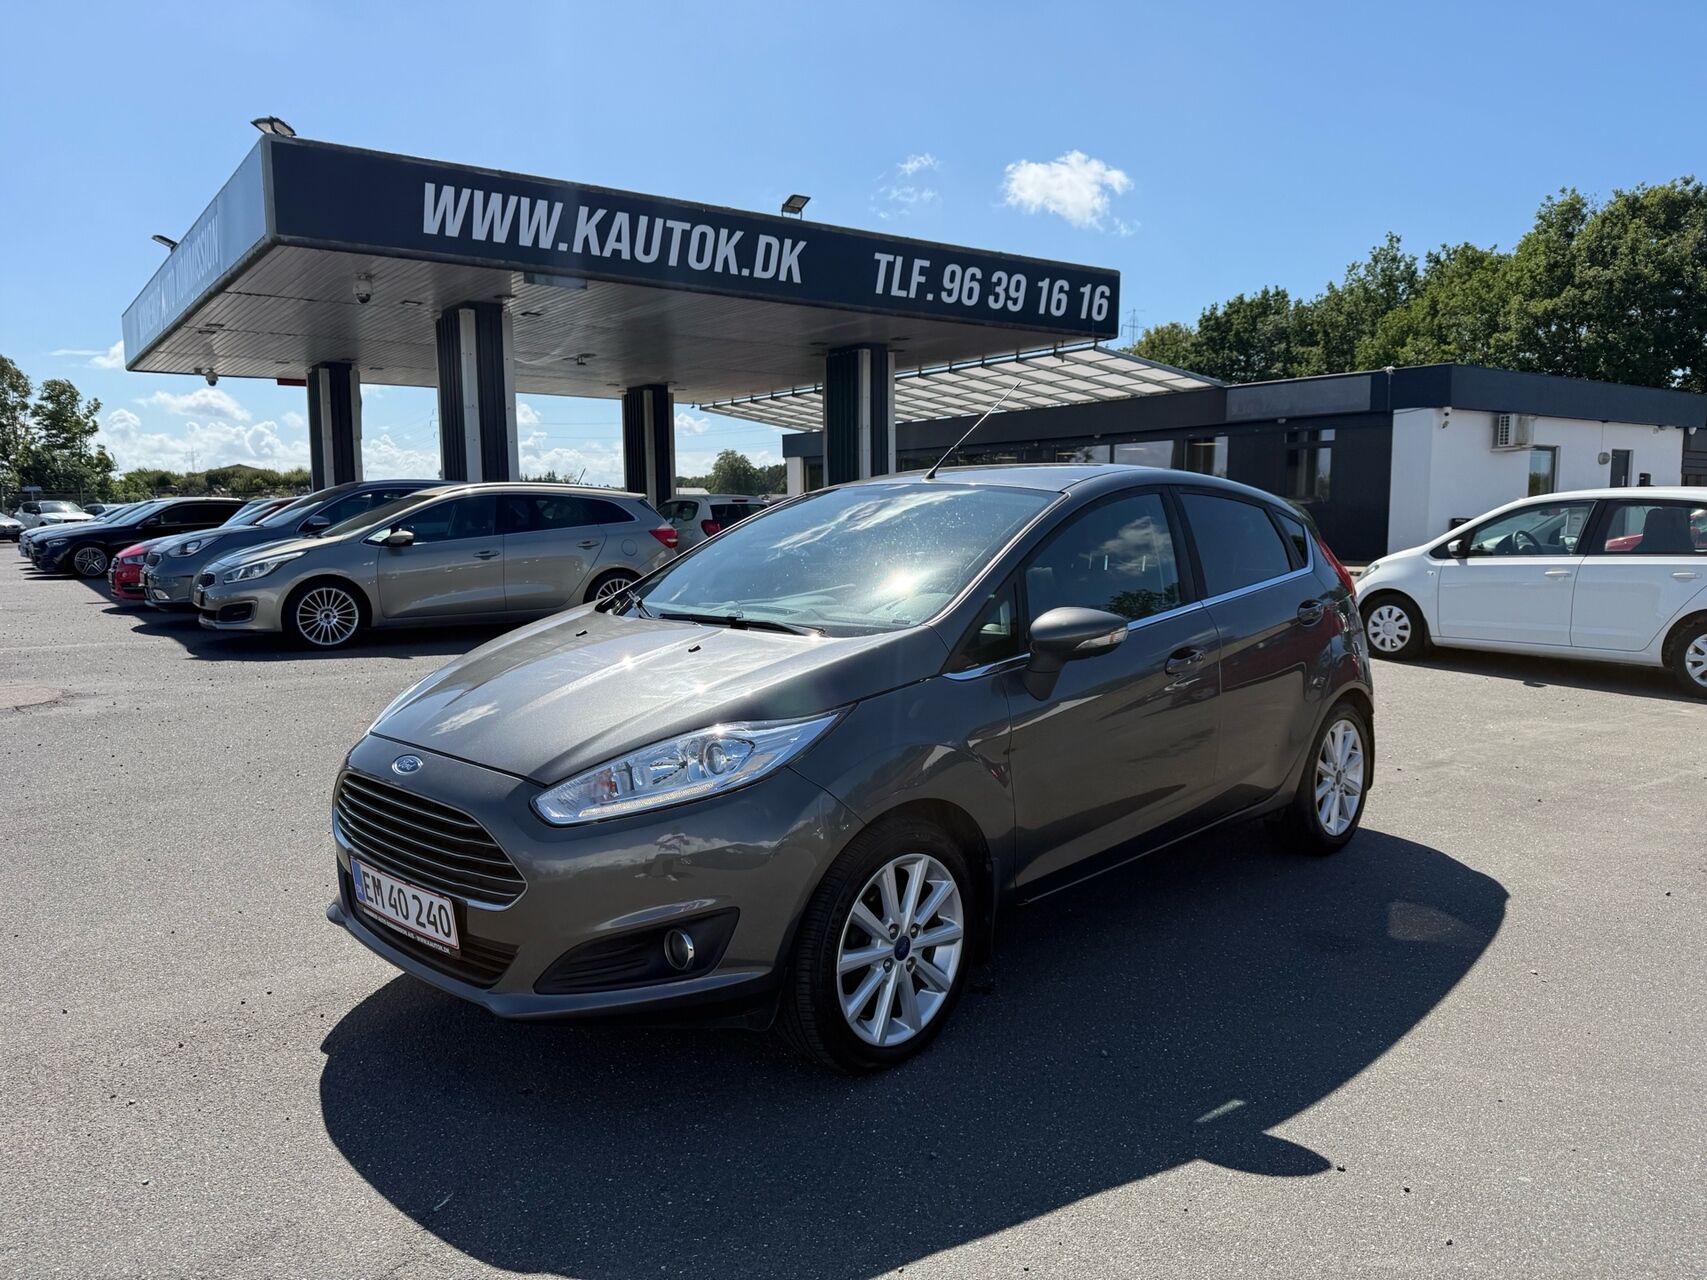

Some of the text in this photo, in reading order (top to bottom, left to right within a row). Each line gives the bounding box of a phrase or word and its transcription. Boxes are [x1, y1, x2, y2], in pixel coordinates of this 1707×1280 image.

[423, 182, 807, 284] WWW.KAUTOK.DK
[874, 252, 1110, 321] TLF. 96 39 16 16
[363, 870, 386, 909] EM
[388, 885, 410, 920] 40
[412, 894, 452, 938] 240
